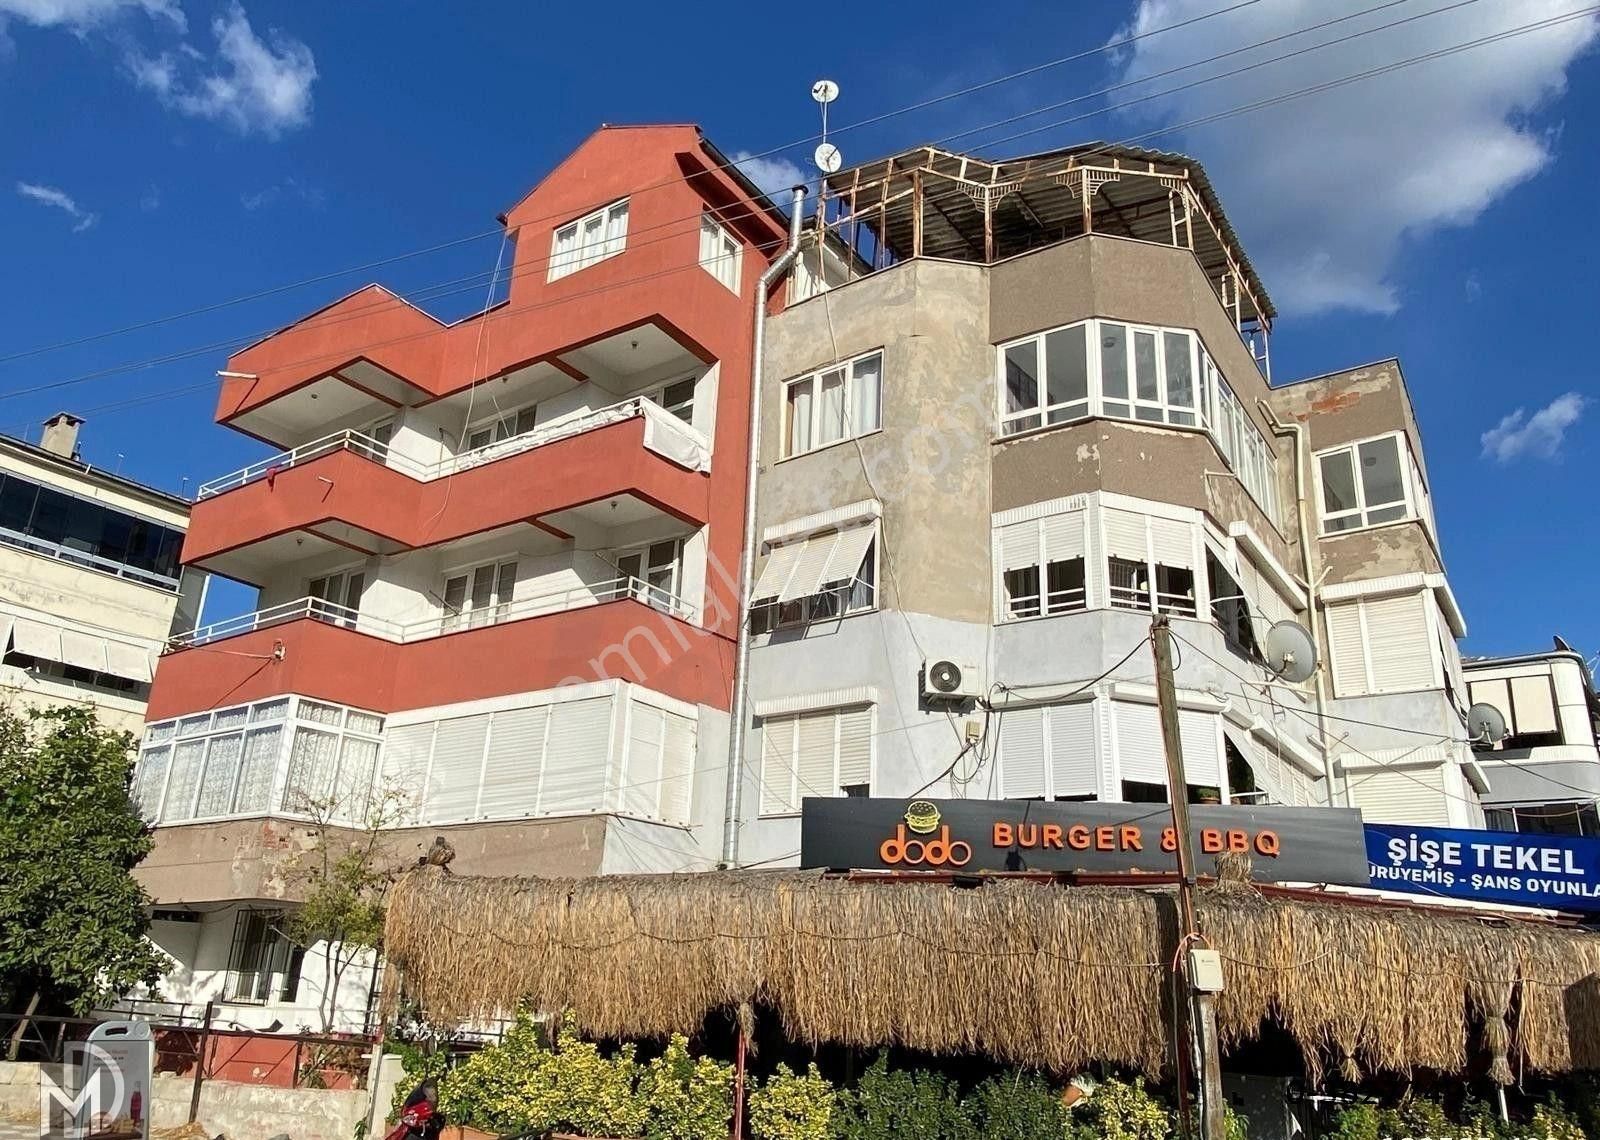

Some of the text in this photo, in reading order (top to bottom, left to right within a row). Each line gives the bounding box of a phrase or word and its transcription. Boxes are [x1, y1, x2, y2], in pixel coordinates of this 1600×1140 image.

[880, 824, 971, 866] dodo
[993, 821, 1280, 858] BURGER & BBQ
[1388, 833, 1585, 875] ŞİŞE TEKEL
[1369, 865, 1455, 887] URUYEMİŞ
[1471, 874, 1522, 890] ŞANS
